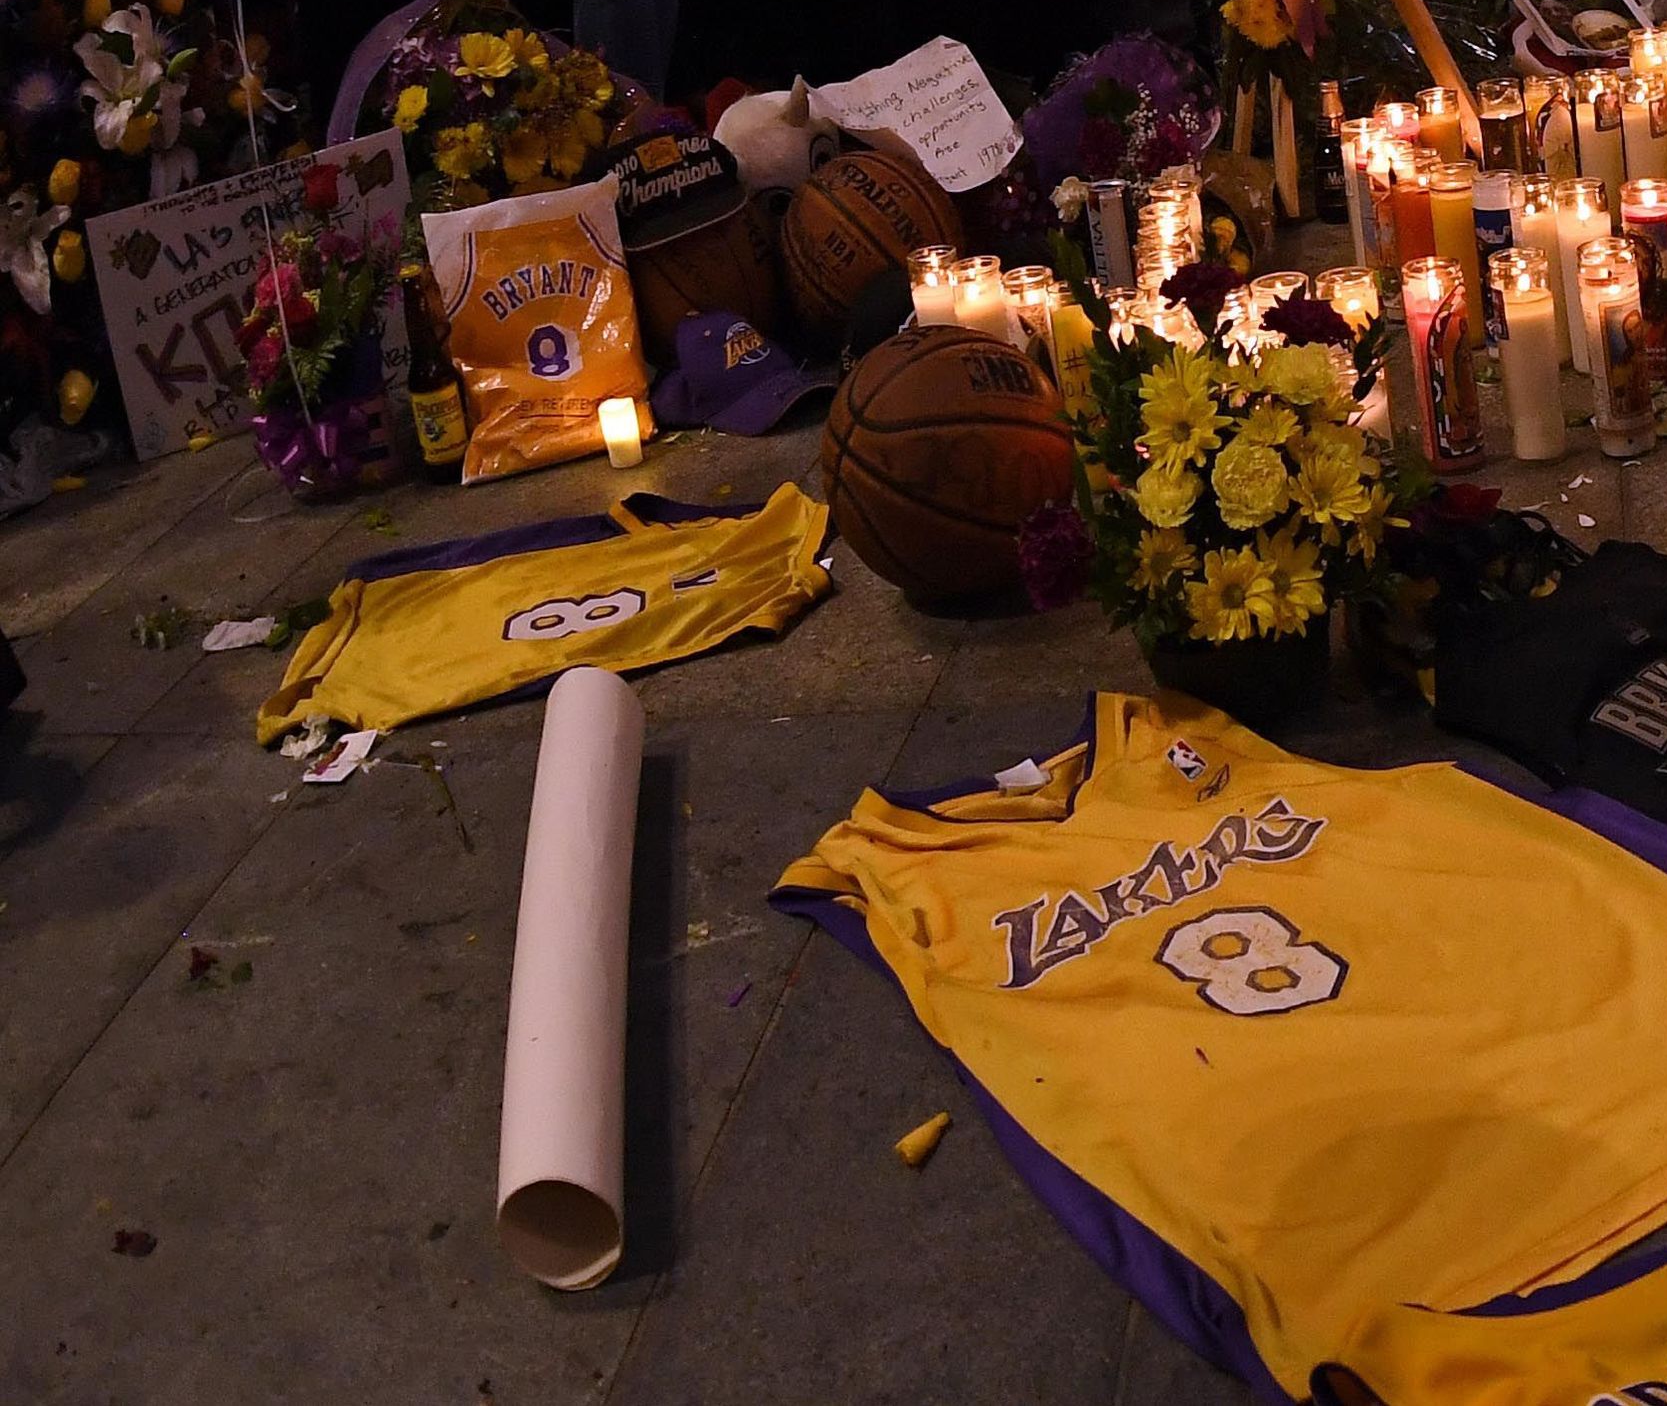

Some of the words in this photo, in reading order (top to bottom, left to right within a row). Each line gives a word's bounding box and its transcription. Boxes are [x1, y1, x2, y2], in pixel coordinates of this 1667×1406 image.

[619, 155, 725, 211] Champions
[827, 230, 857, 267] NBA
[482, 260, 600, 322] BRYANT
[502, 587, 646, 640] 8
[992, 796, 1329, 989] LAKERS
[1153, 904, 1350, 1017] 8
